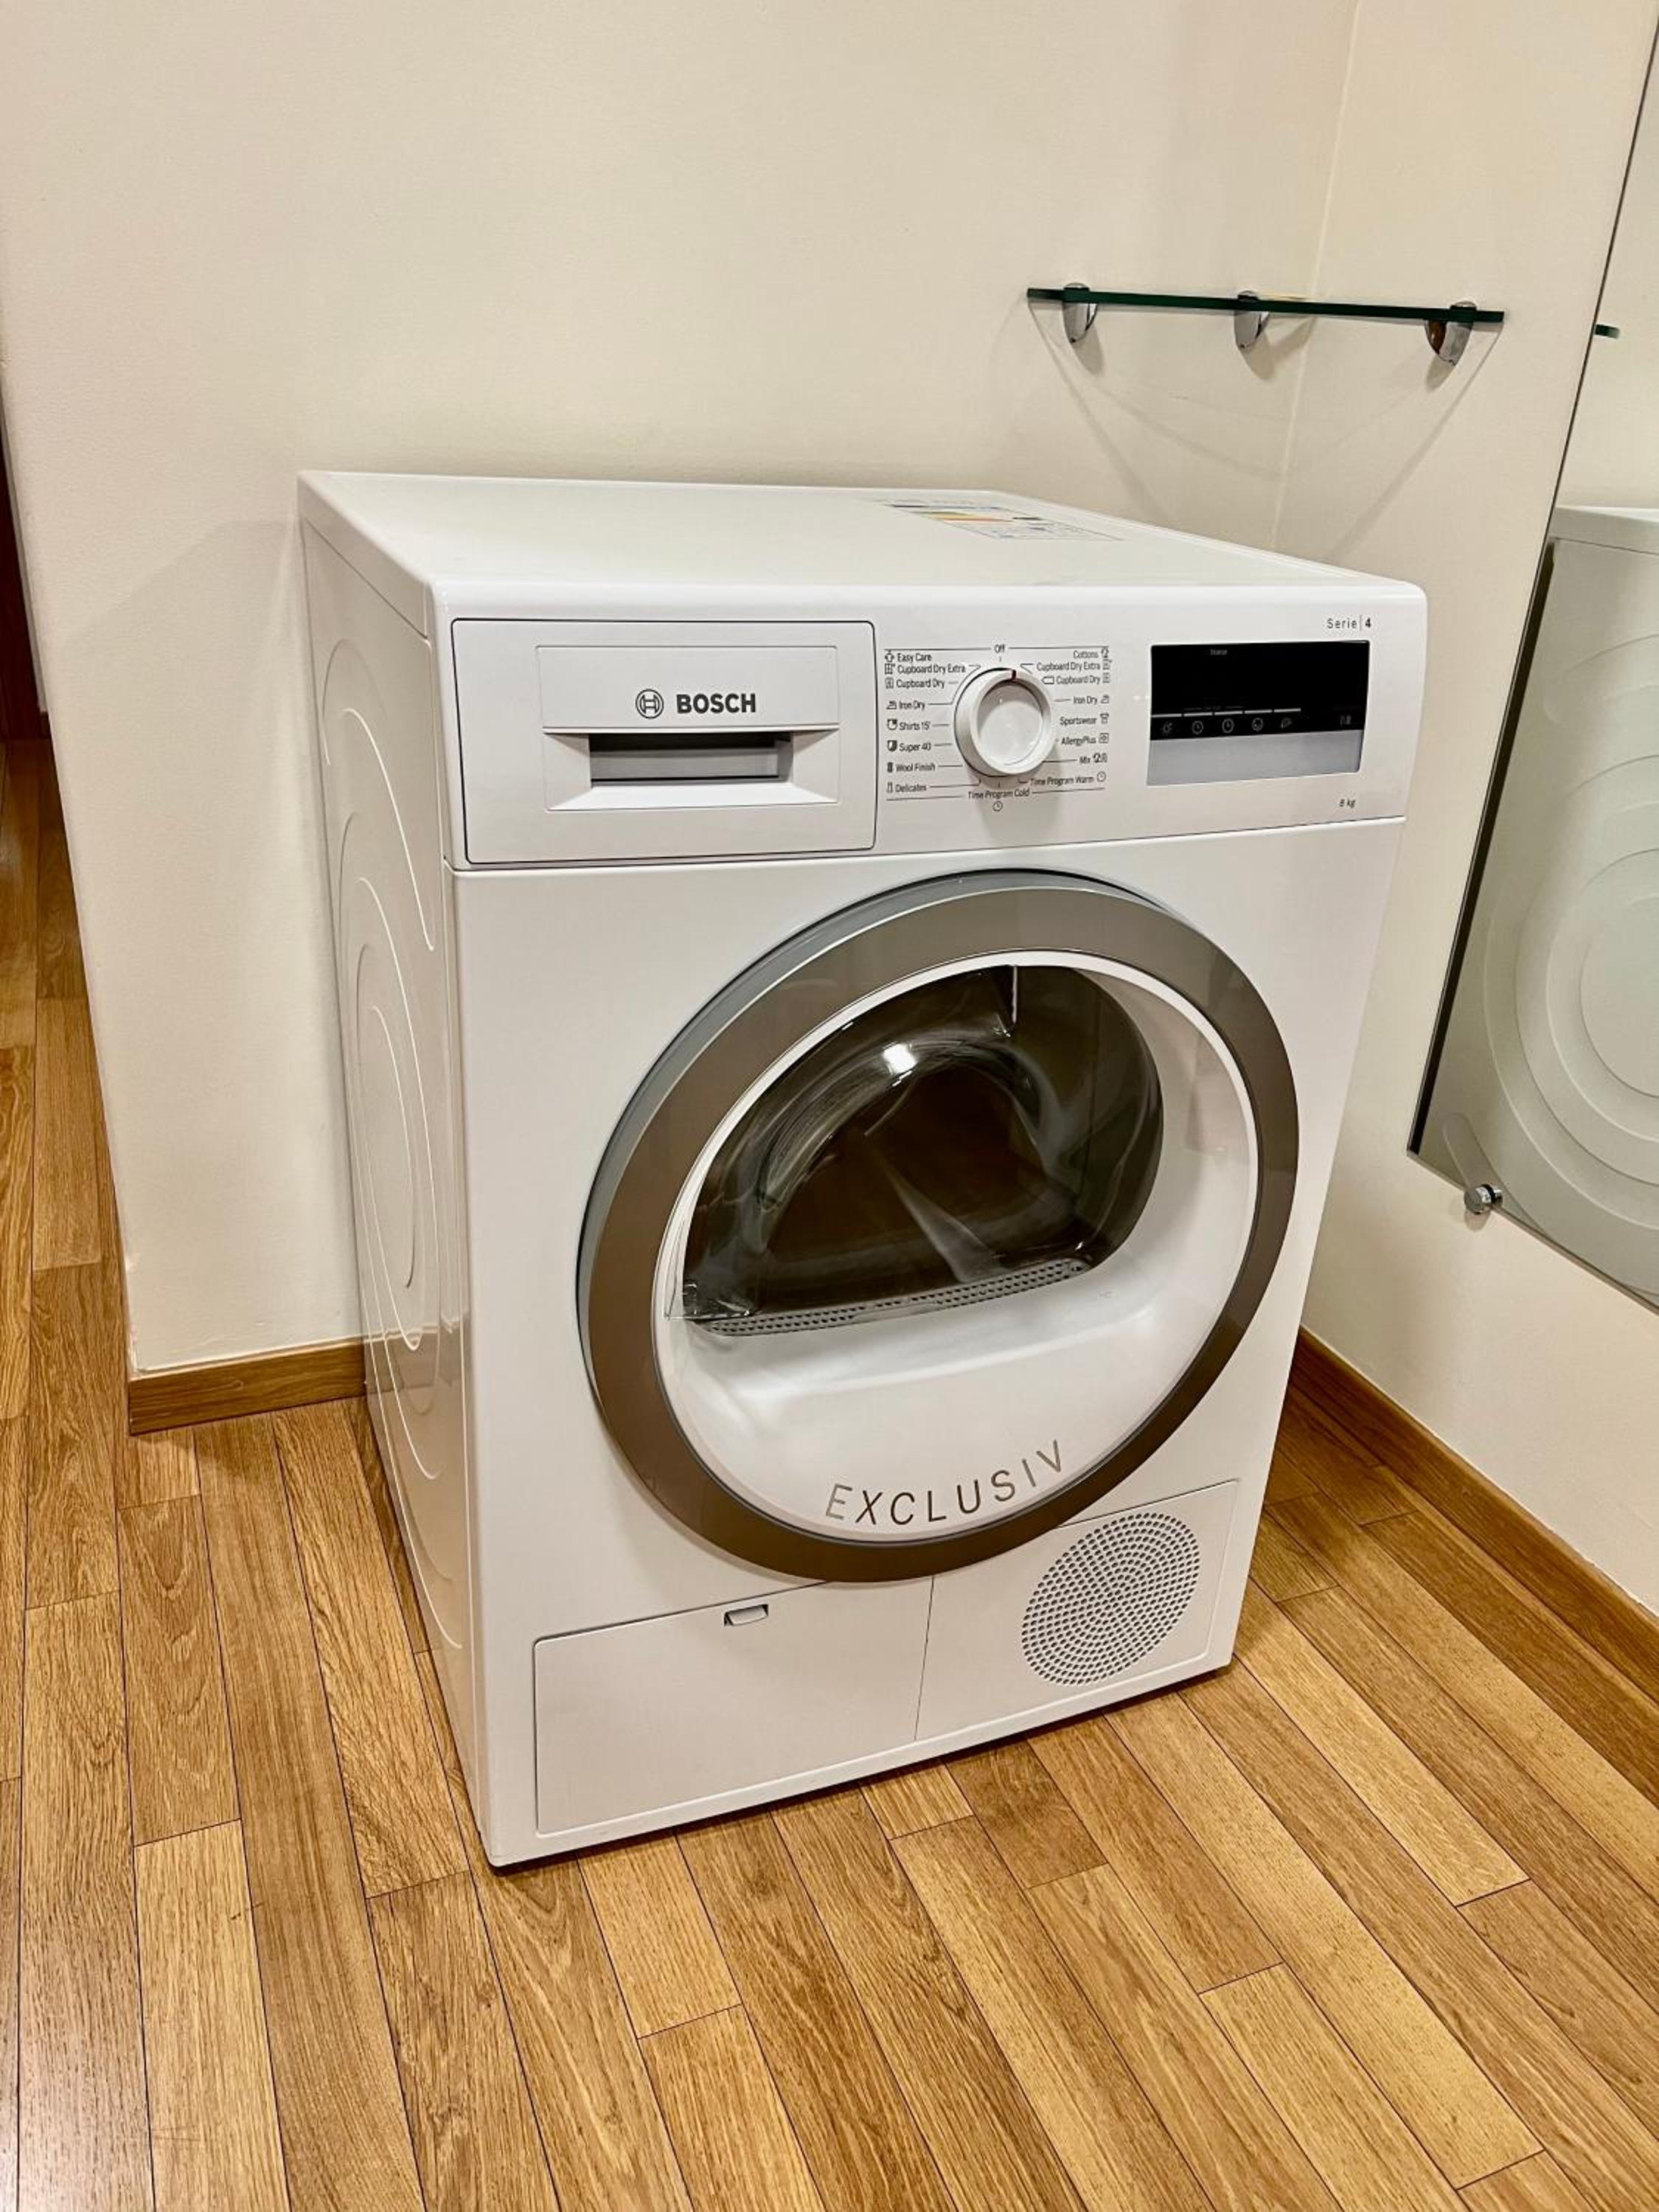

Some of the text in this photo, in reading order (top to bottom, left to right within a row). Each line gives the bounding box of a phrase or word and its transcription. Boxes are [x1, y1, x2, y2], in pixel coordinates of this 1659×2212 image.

[1326, 618, 1371, 629] Serie 4
[995, 644, 1005, 653] Off
[897, 653, 932, 662] Easy Care
[1073, 650, 1099, 658] Cottons
[897, 664, 966, 674] Cupboard Dry Extra
[1037, 661, 1100, 672] Cupboard Dry Extra
[897, 679, 945, 689] Cupboard Dry
[1056, 675, 1100, 685] Cupboard Dry
[676, 693, 756, 714] BOSCH
[1073, 696, 1098, 705] Iron Dry
[899, 701, 925, 711] Iron Dry
[899, 722, 920, 730] Shirts
[1060, 716, 1097, 726] Sportswear
[1061, 736, 1096, 746] AllergyPlus
[899, 742, 920, 752] Super
[1079, 755, 1091, 763] Mix
[897, 762, 936, 771] Wool Finish
[1030, 775, 1095, 787] Time Program Warm
[896, 784, 927, 793] Delicates
[968, 788, 1030, 799] Time Program Cold
[1346, 798, 1356, 808] kg
[825, 1439, 1061, 1526] EXCLUSIV
